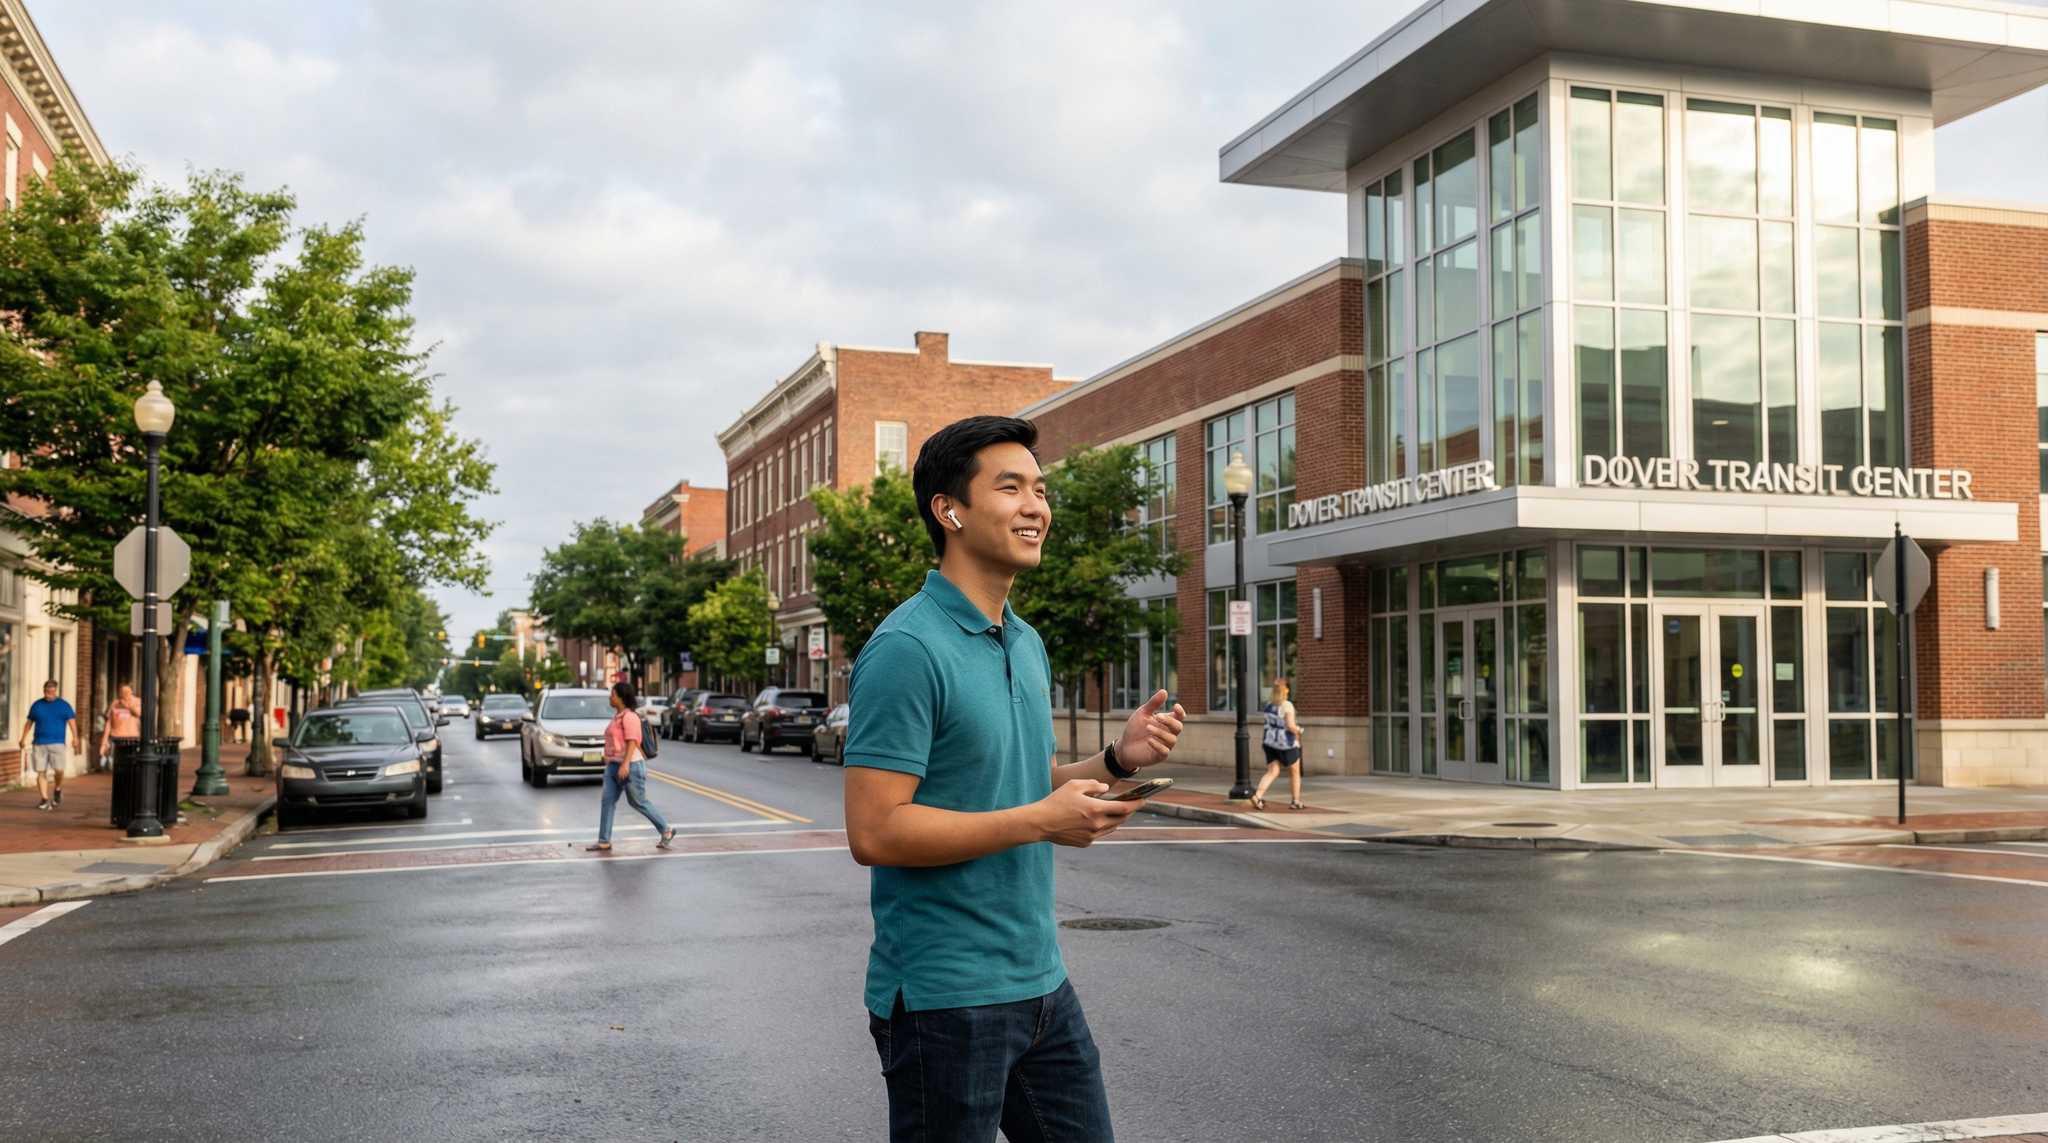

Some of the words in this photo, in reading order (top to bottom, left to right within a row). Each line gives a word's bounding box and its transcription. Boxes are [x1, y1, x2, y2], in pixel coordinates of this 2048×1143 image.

[1288, 495, 1341, 528] DOVER
[1342, 478, 1412, 518] TRANSIT
[1415, 460, 1497, 499] CENTER
[1583, 454, 1700, 489] DOVER
[1708, 459, 1844, 494] TRANSIT
[1852, 465, 1973, 499] CENTER
